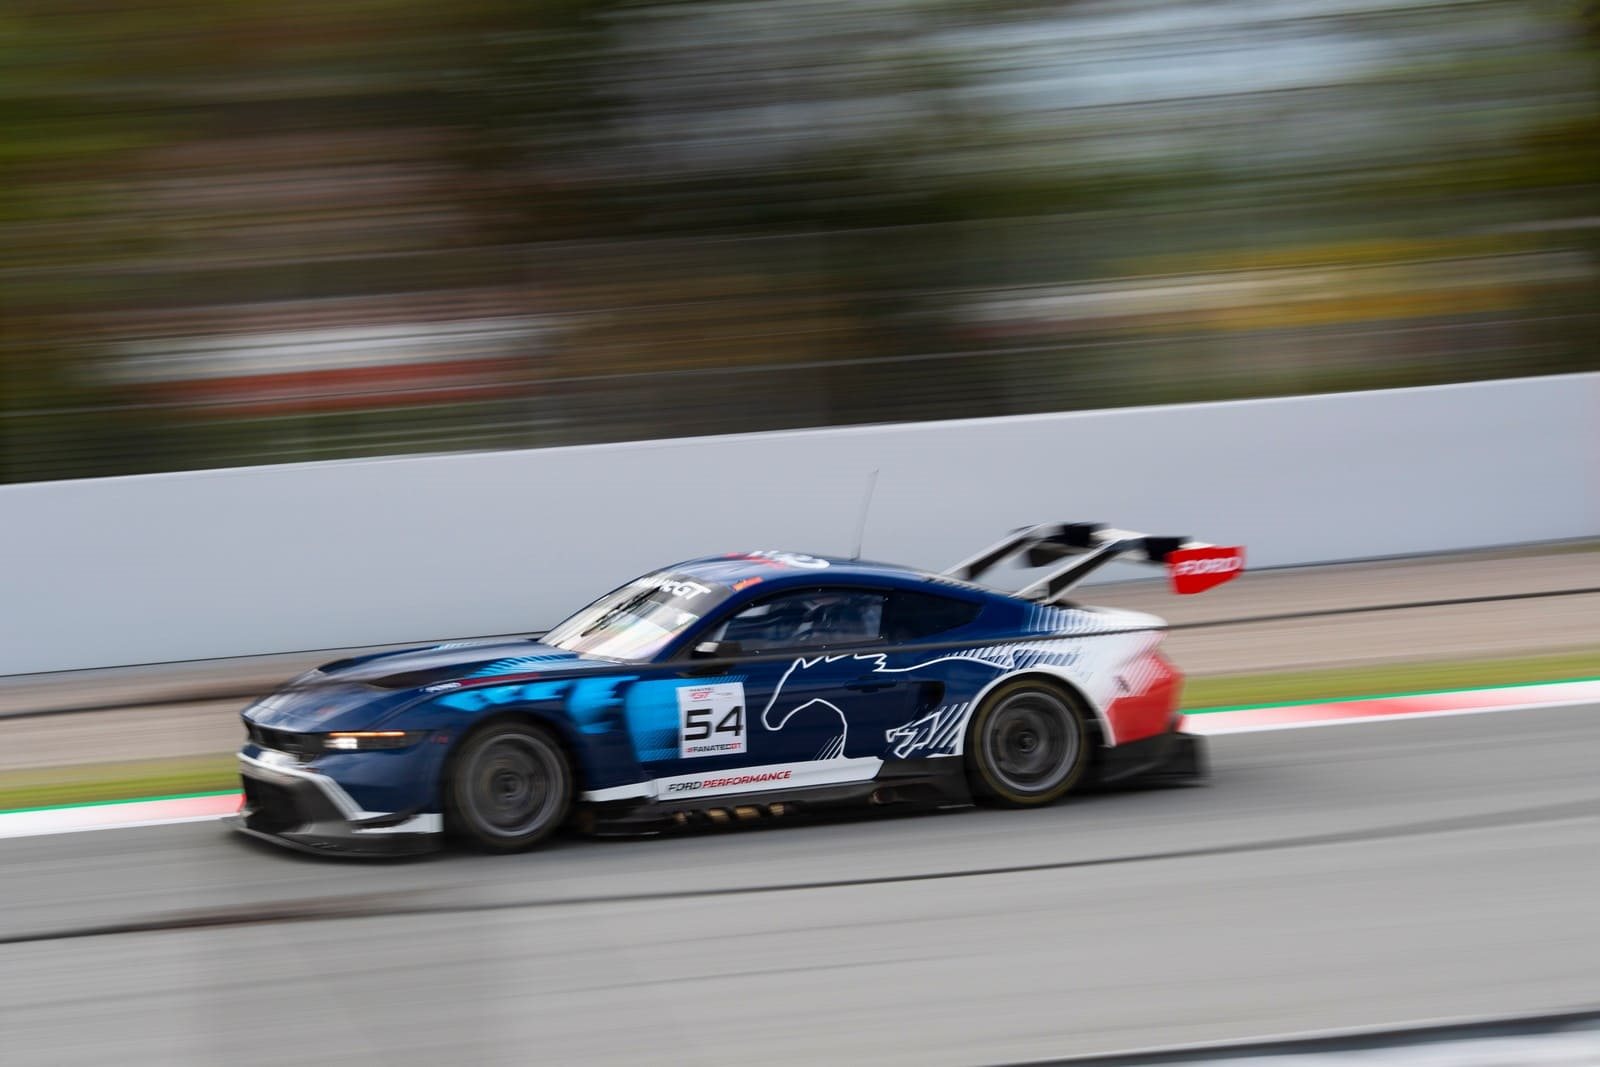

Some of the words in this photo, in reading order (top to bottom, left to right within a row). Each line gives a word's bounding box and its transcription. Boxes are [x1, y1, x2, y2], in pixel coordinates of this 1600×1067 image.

[1175, 556, 1243, 576] FORD
[684, 705, 744, 741] 54
[668, 781, 702, 792] FORD
[702, 770, 792, 789] PERFORMANCE
